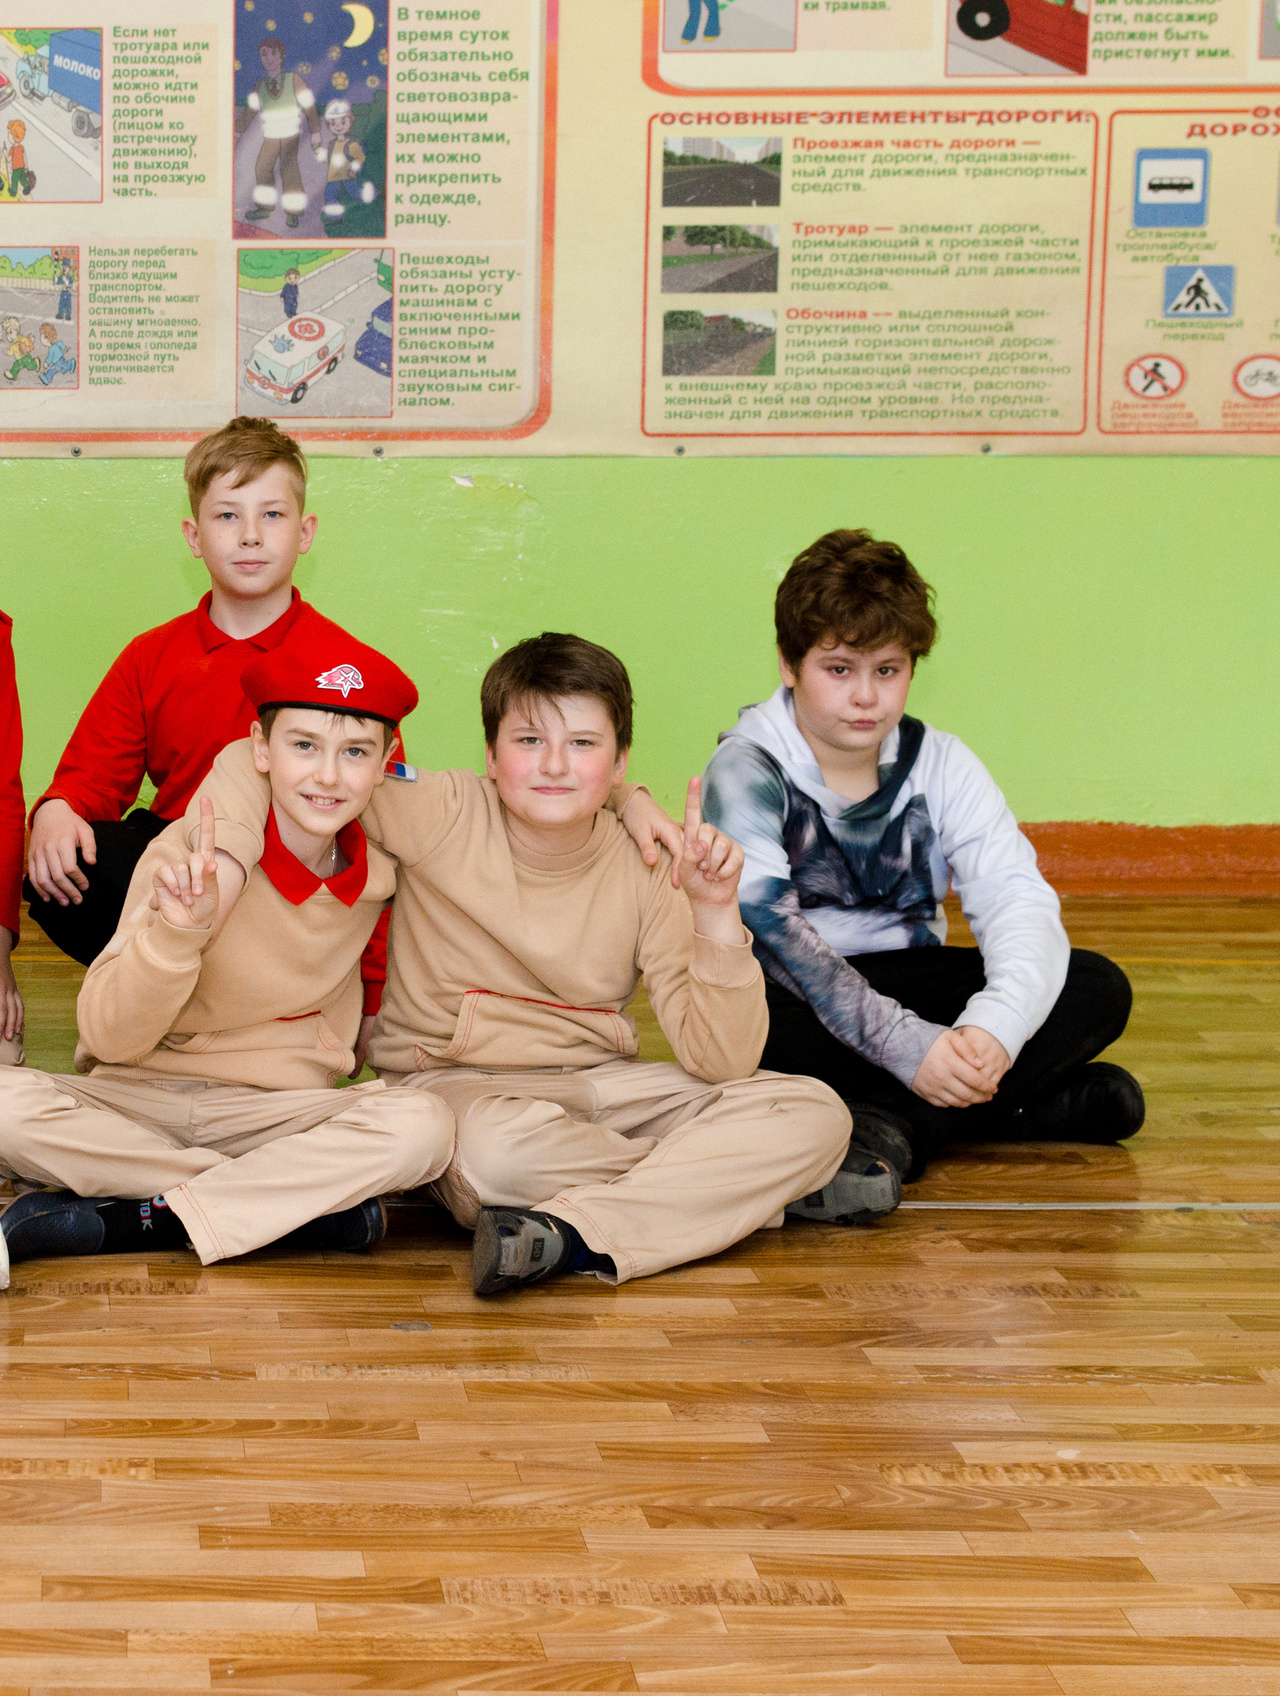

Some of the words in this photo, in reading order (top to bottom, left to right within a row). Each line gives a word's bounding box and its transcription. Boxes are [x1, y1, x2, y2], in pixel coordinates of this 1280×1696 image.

[397, 6, 409, 20] В
[416, 9, 481, 20] темное
[1134, 12, 1218, 24] пассажир
[113, 25, 148, 37] Если
[153, 28, 176, 37] нет
[397, 30, 453, 44] время
[459, 30, 509, 44] суток
[1092, 31, 1158, 42] должен
[1164, 27, 1209, 41] быть
[113, 41, 178, 53] тротуара
[183, 41, 209, 50] или
[113, 50, 202, 65] пешеходной
[396, 47, 513, 61] обязательно
[1092, 48, 1189, 61] пристегнут
[53, 54, 101, 81] МОЛОКО
[112, 68, 178, 79] дорожки,
[396, 68, 481, 82] обозначь
[488, 67, 529, 81] себя
[396, 91, 518, 103] световозвра-
[396, 112, 488, 124] щающими
[659, 111, 809, 125] ОСНОВНЫЕ
[819, 110, 966, 125] ЭЛЕМЕНТЫ
[976, 110, 1092, 126] ДОРОГИ:
[396, 132, 510, 143] элементами,
[400, 252, 489, 265] Пешеходы
[399, 266, 473, 279] обязаны
[479, 269, 521, 281] усту-
[399, 284, 438, 293] пить
[444, 283, 503, 295] дорогу
[399, 298, 478, 307] машинам
[484, 297, 492, 307] с
